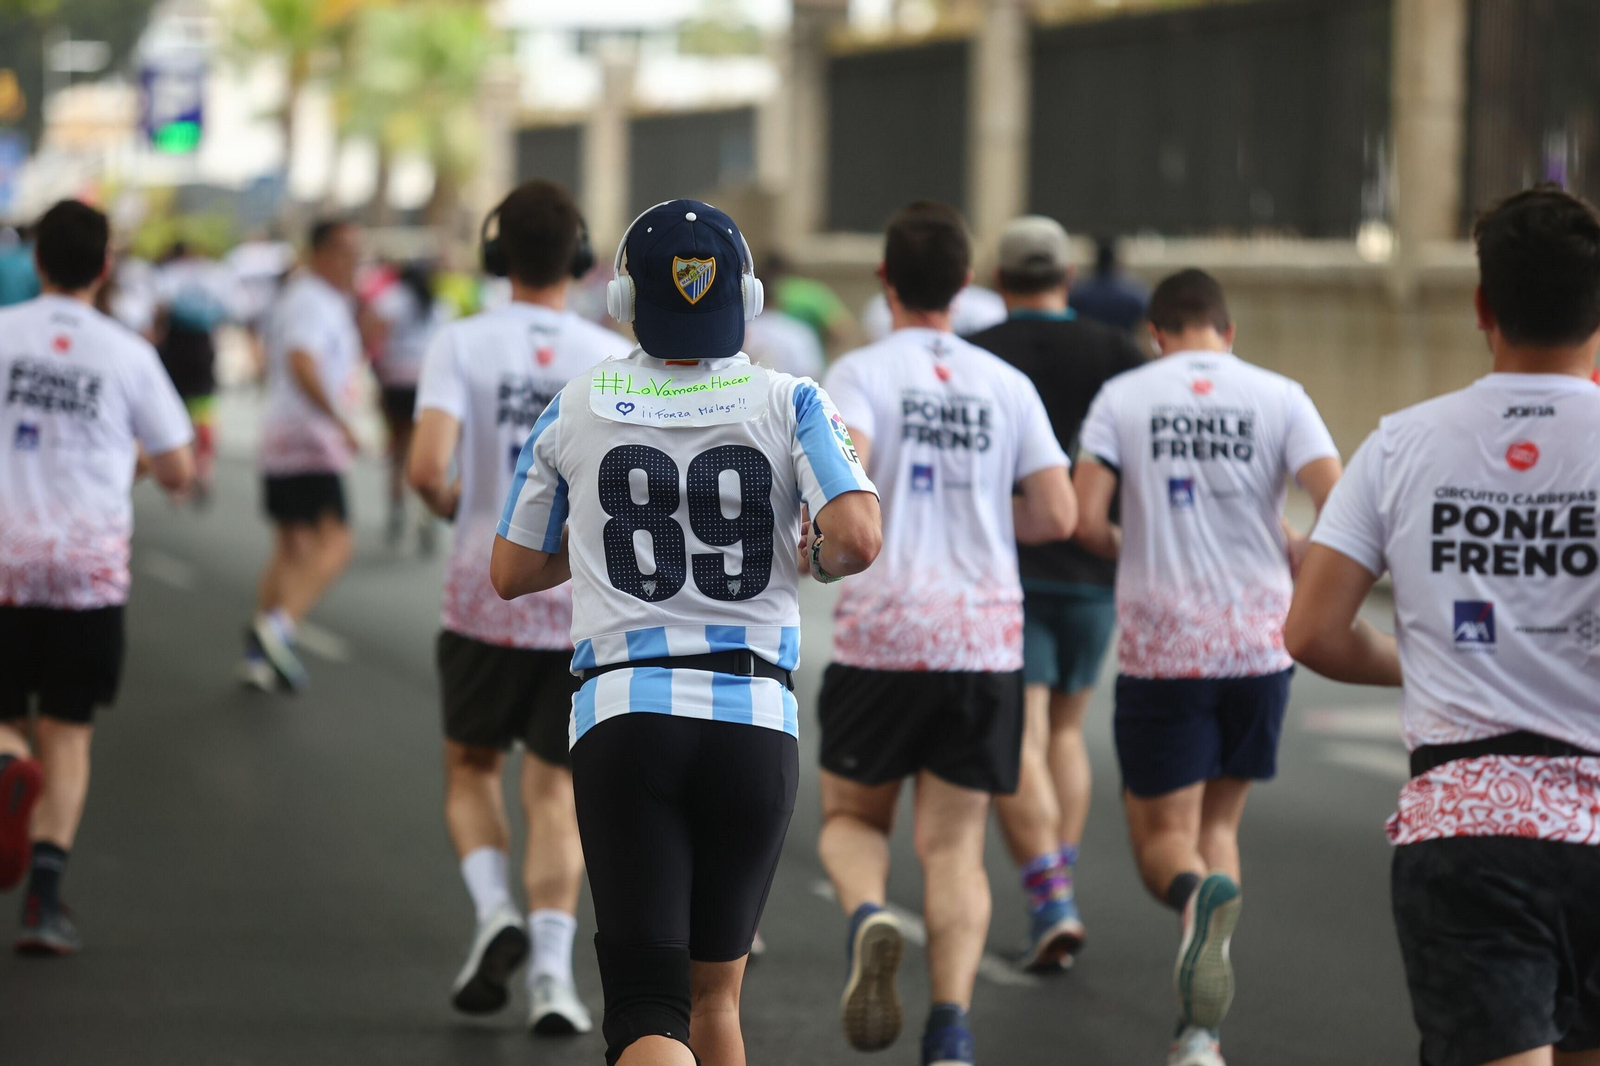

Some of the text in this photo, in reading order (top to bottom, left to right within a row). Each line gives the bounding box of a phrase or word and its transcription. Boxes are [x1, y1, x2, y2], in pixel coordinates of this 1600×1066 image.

[903, 400, 992, 428] PONLE
[1152, 415, 1254, 438] PONLE
[902, 424, 990, 452] FRENO
[1152, 440, 1253, 461] FRENO
[1435, 486, 1597, 505] CIRCUITO CARRERAS
[598, 445, 774, 602] 89
[1432, 503, 1596, 539] PONLE
[1431, 541, 1598, 577] FRENO
[1453, 620, 1490, 640] AXA
